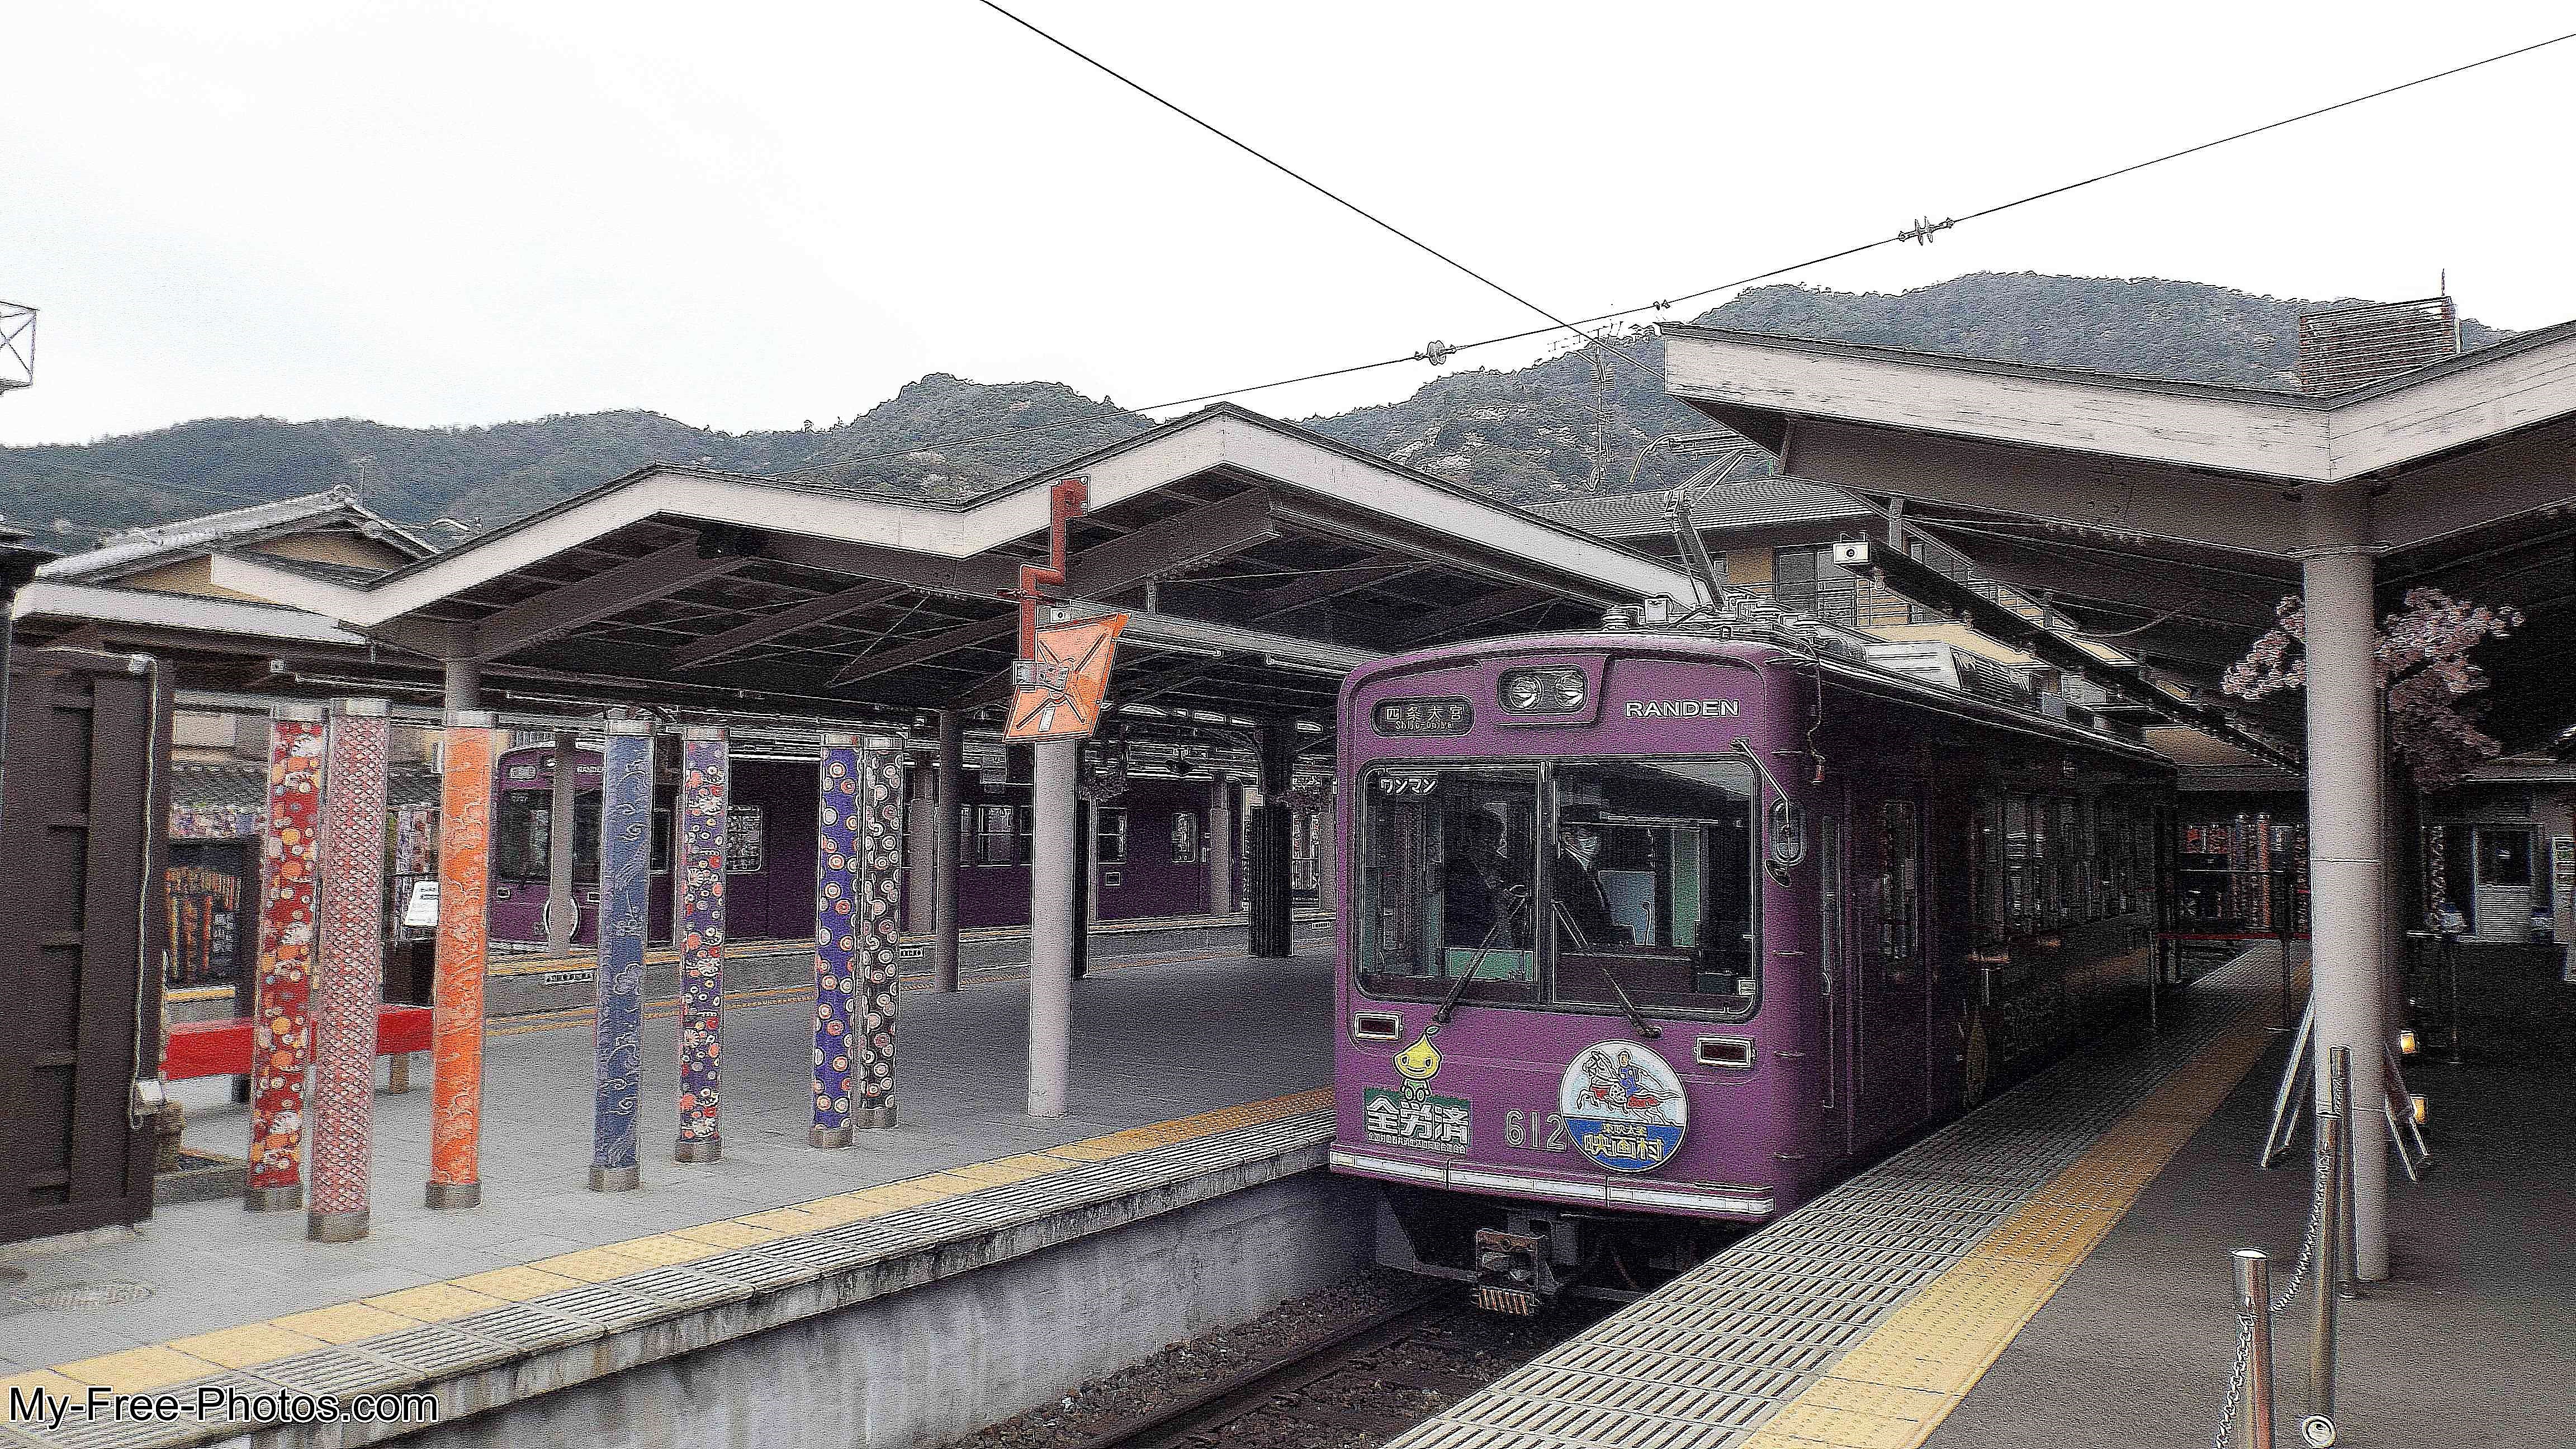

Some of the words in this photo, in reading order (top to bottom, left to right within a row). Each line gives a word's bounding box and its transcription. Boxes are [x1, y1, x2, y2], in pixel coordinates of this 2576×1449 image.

[1386, 705, 1462, 721] 四条大宮
[1626, 700, 1739, 717] RANDEN
[1380, 778, 1436, 793] ワンマン
[1366, 1096, 1469, 1144] 全労済
[1506, 1110, 1566, 1150] 612
[1584, 1134, 1663, 1161] 映画村
